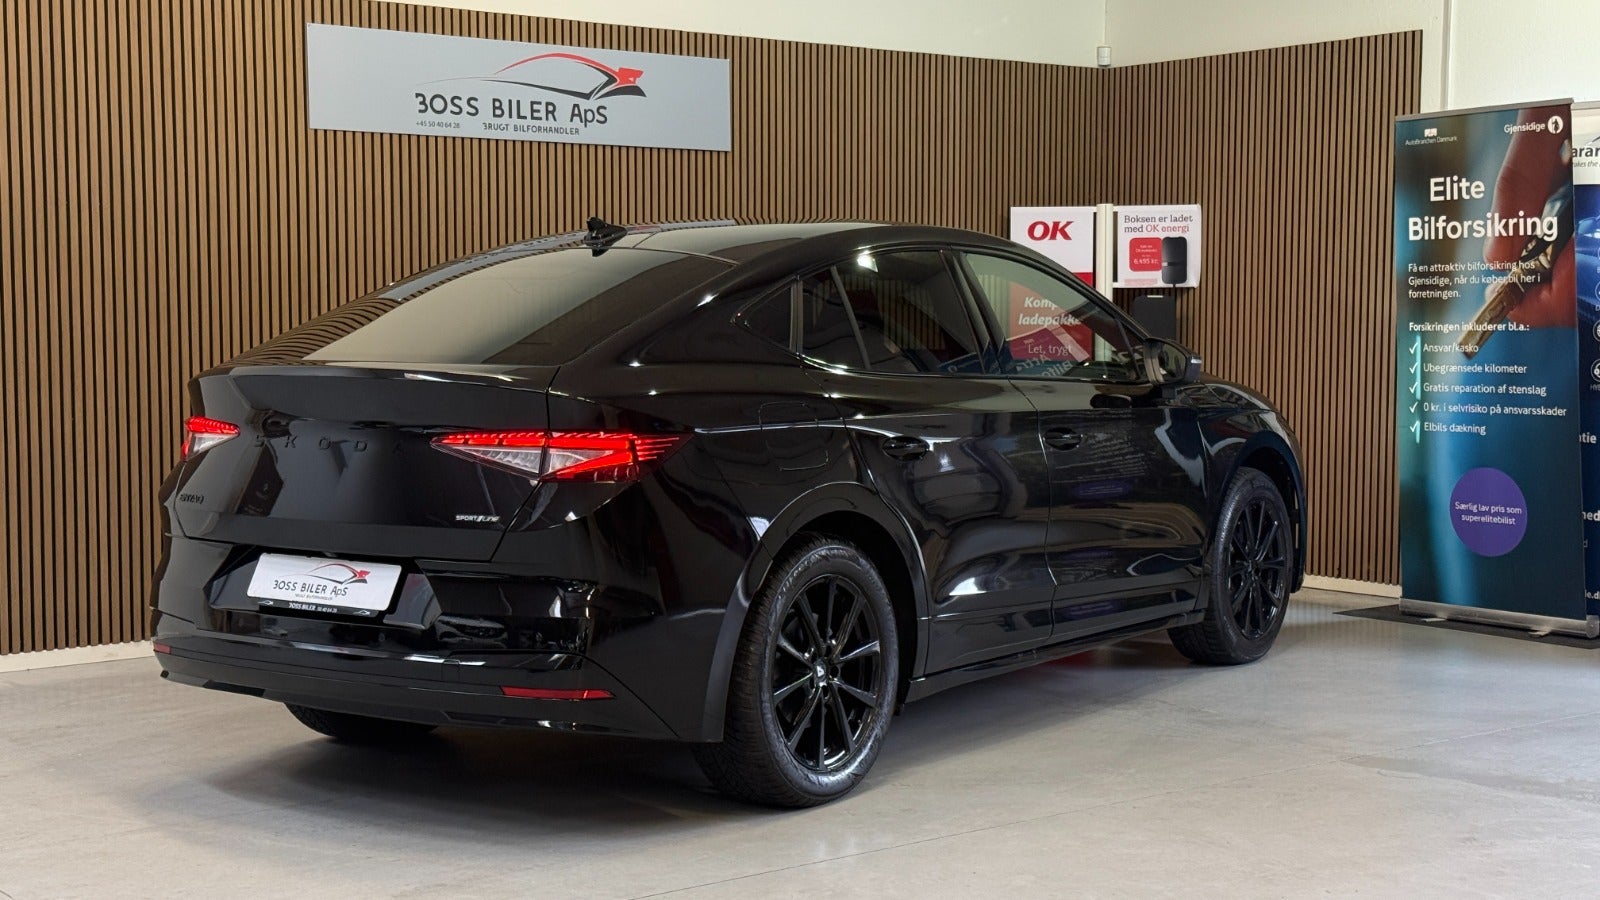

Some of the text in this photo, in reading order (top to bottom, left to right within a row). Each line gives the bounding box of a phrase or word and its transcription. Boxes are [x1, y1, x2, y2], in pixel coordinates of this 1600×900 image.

[492, 98, 557, 122] BILER
[570, 103, 608, 128] ApS
[513, 124, 580, 136] BILFORHANDLER
[1504, 122, 1546, 133] Gjensidige
[1430, 175, 1485, 201] Elite
[1124, 214, 1156, 223] Boksen
[1170, 214, 1193, 222] ladet
[1027, 220, 1074, 240] OK
[1146, 224, 1159, 232] OK
[1162, 224, 1190, 234] energi
[1408, 211, 1558, 243] Bilforsikring
[1408, 264, 1417, 272] Få
[1430, 262, 1465, 272] attraktiv
[1468, 261, 1516, 272] bilforsikring
[1519, 260, 1535, 269] hos
[1409, 276, 1452, 287] Gjensidige,
[1454, 275, 1468, 284] når
[1470, 275, 1480, 284] du
[1482, 275, 1506, 284] køber
[1508, 274, 1518, 283] bil
[1520, 274, 1536, 282] her
[1409, 289, 1460, 300] forretningen.
[1409, 322, 1460, 333] Forsikringen
[1461, 322, 1506, 331] inkluderer
[1028, 344, 1072, 356] Let, trygt
[1423, 343, 1479, 352] Ansvar/kasko
[1423, 363, 1527, 374] Ubegrænsede kilometer
[1424, 382, 1546, 397] Gratis reparation af stenslag
[1431, 403, 1441, 412] kr.
[1448, 403, 1488, 413] selvrisiko
[1490, 404, 1501, 416] på
[1504, 406, 1566, 416] ansvarsskader
[1424, 422, 1486, 435] Elbils dækning
[1580, 432, 1596, 444] tie
[1455, 502, 1477, 512] Særlig
[1479, 504, 1489, 512] lav
[1491, 505, 1505, 513] pris
[1462, 515, 1515, 524] superelitebilist
[301, 582, 327, 594] BILER
[330, 585, 348, 597] ApS
